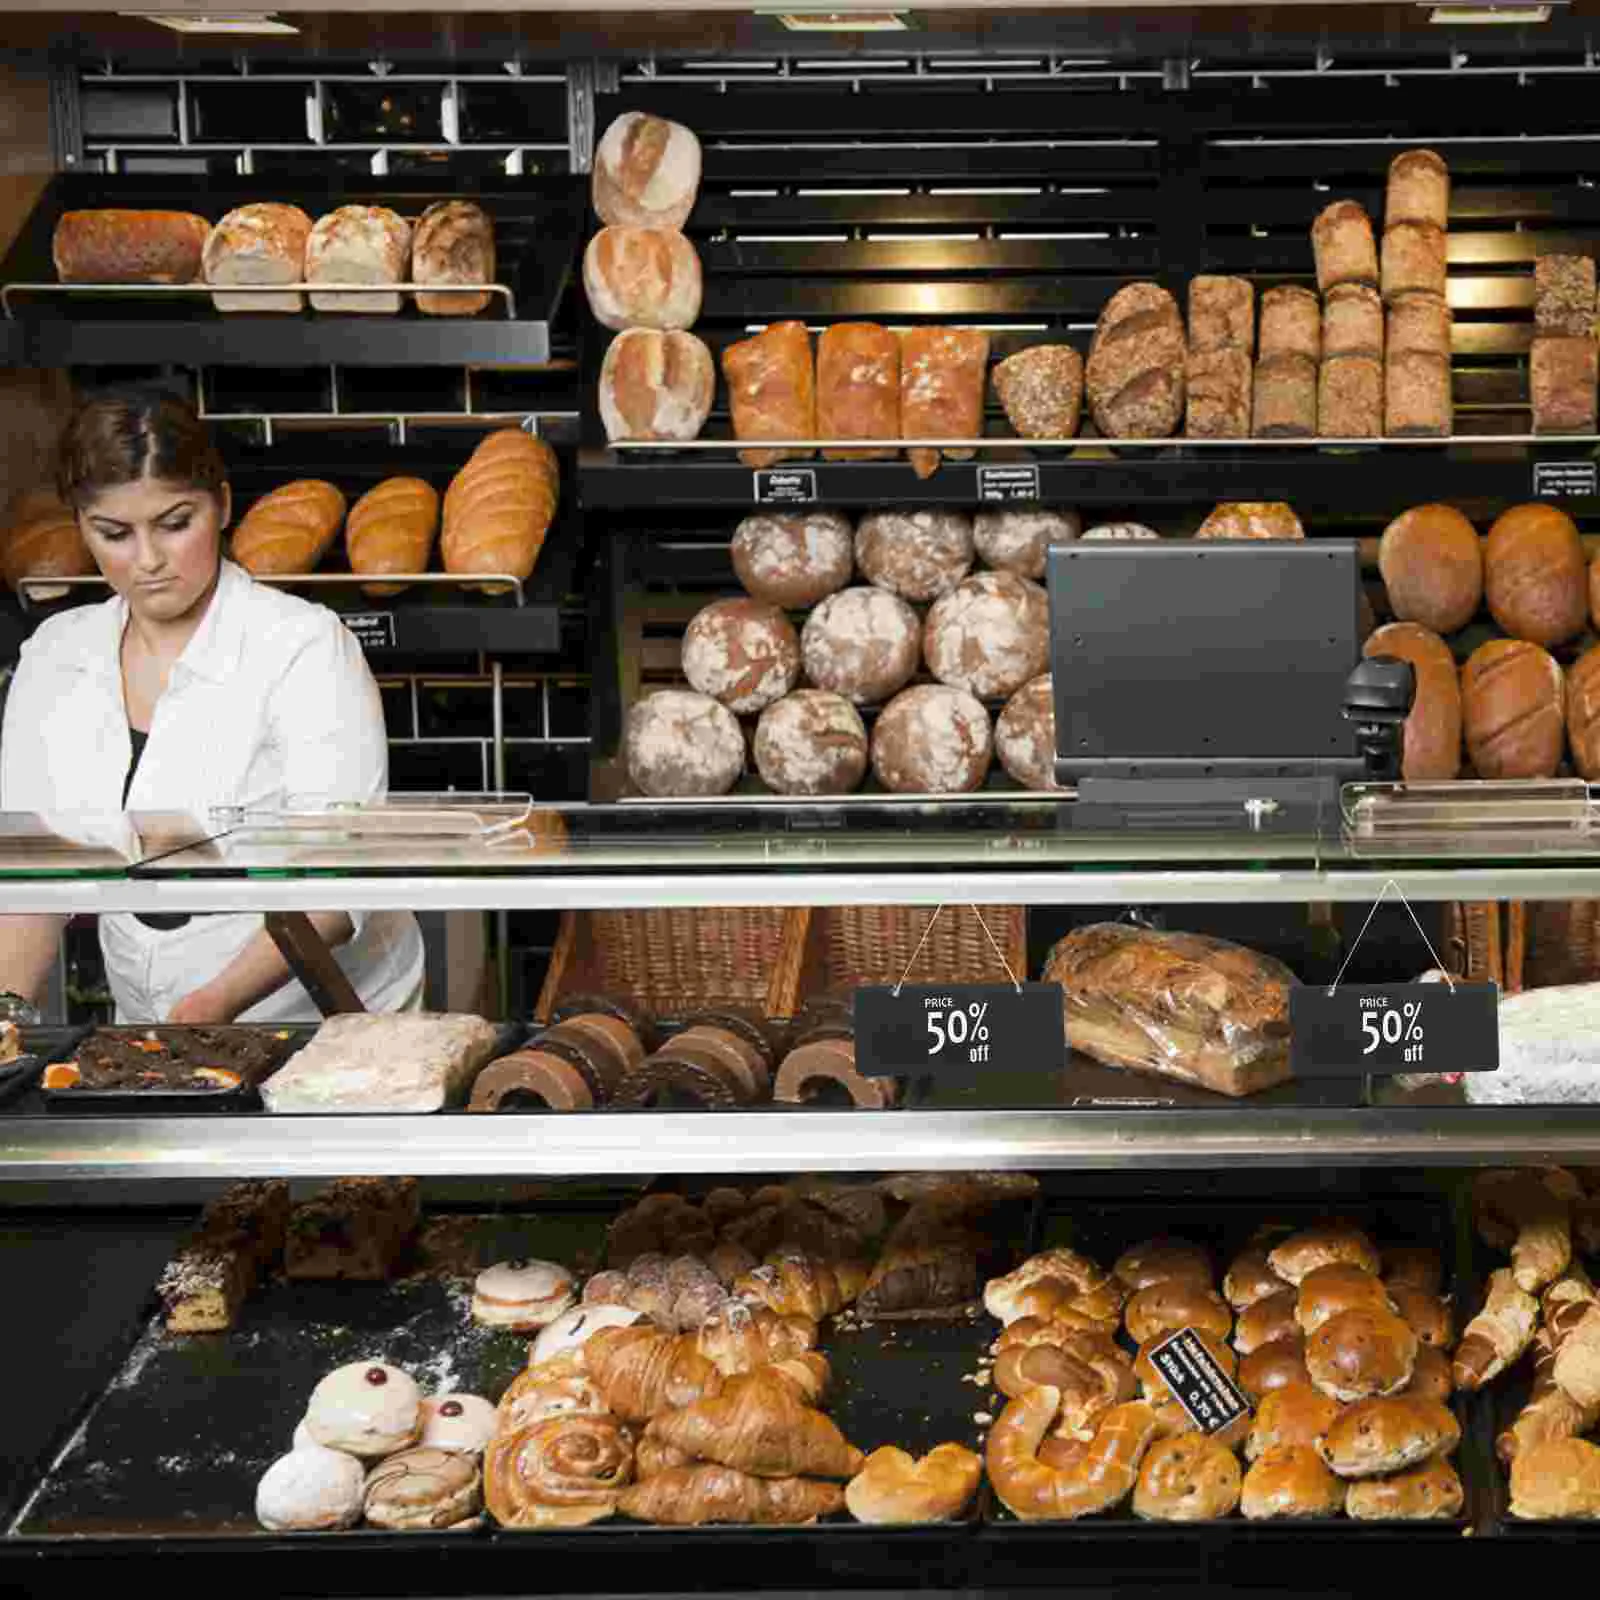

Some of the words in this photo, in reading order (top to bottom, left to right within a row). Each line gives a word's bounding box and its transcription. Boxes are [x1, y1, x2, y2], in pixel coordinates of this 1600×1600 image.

[924, 997, 953, 1009] PRICE
[1359, 997, 1388, 1009] PRICE
[927, 1002, 989, 1055] 50%
[1362, 1002, 1424, 1055] 50%
[969, 1044, 989, 1063] off
[1404, 1044, 1424, 1062] off
